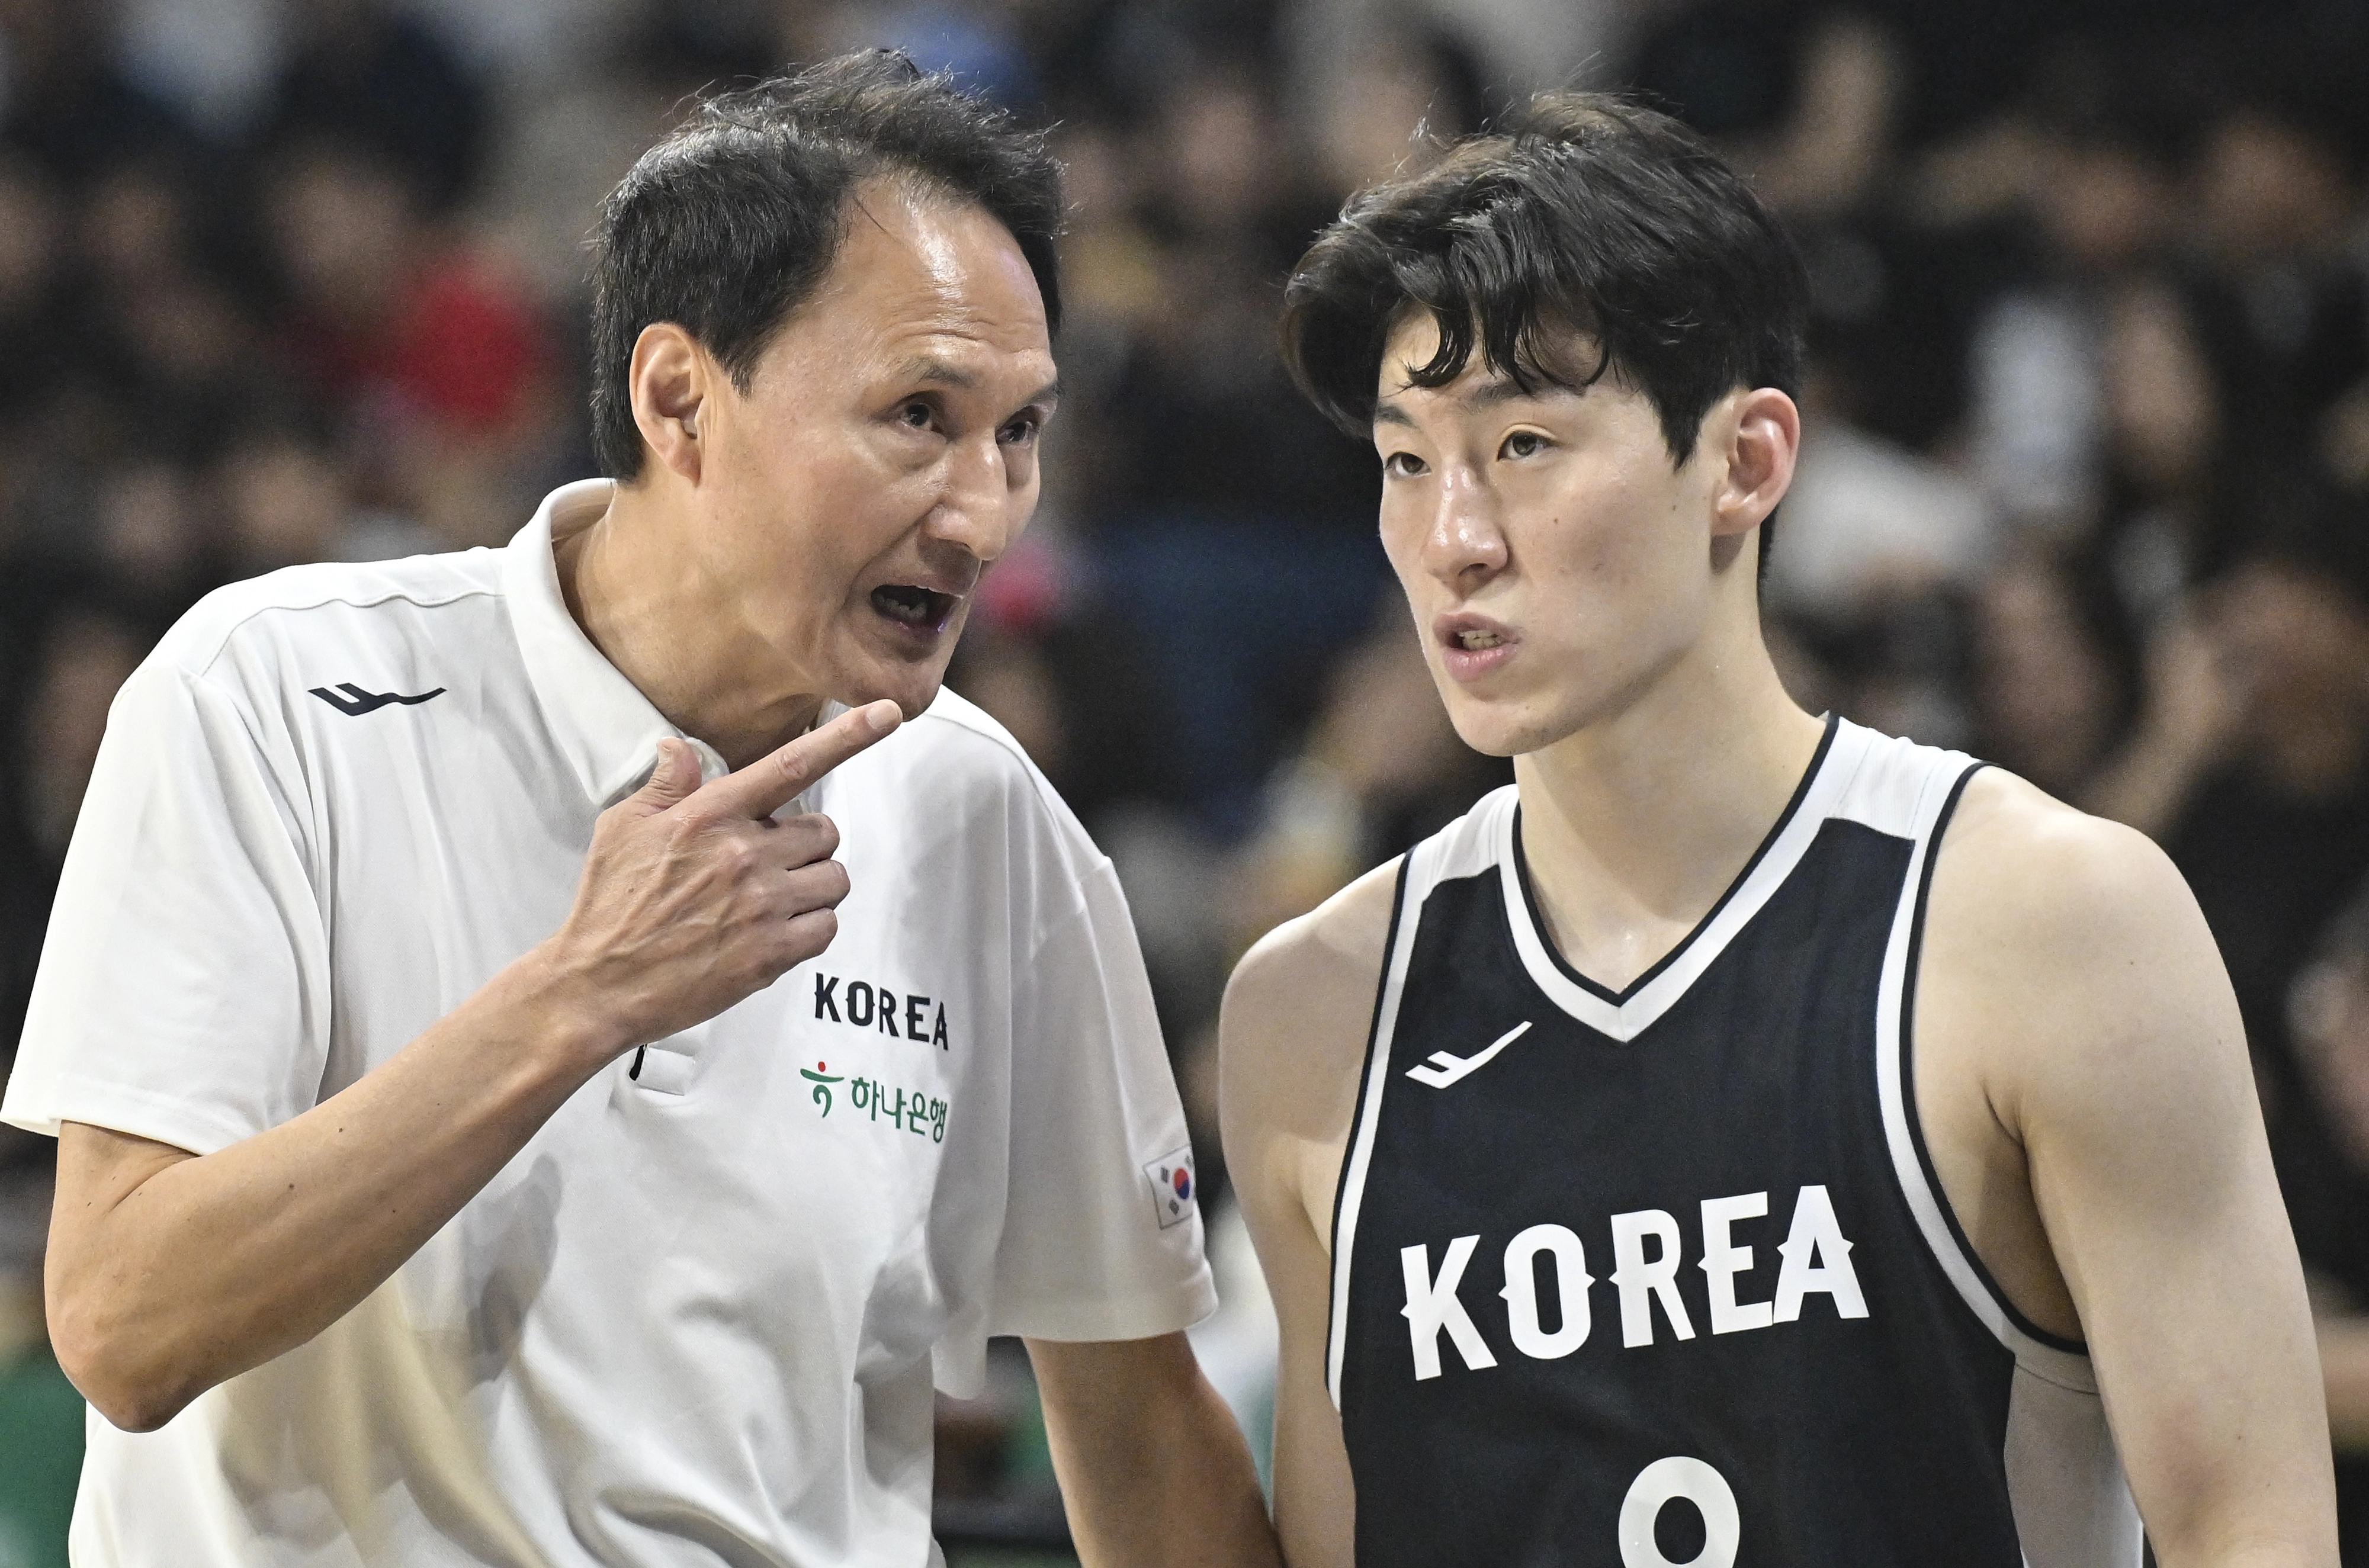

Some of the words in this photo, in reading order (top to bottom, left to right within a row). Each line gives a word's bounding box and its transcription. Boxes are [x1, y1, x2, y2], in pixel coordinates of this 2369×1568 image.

[814, 972, 948, 1051] KOREA
[851, 1077, 947, 1143] 하나은행
[1400, 1184, 1869, 1380] KOREA
